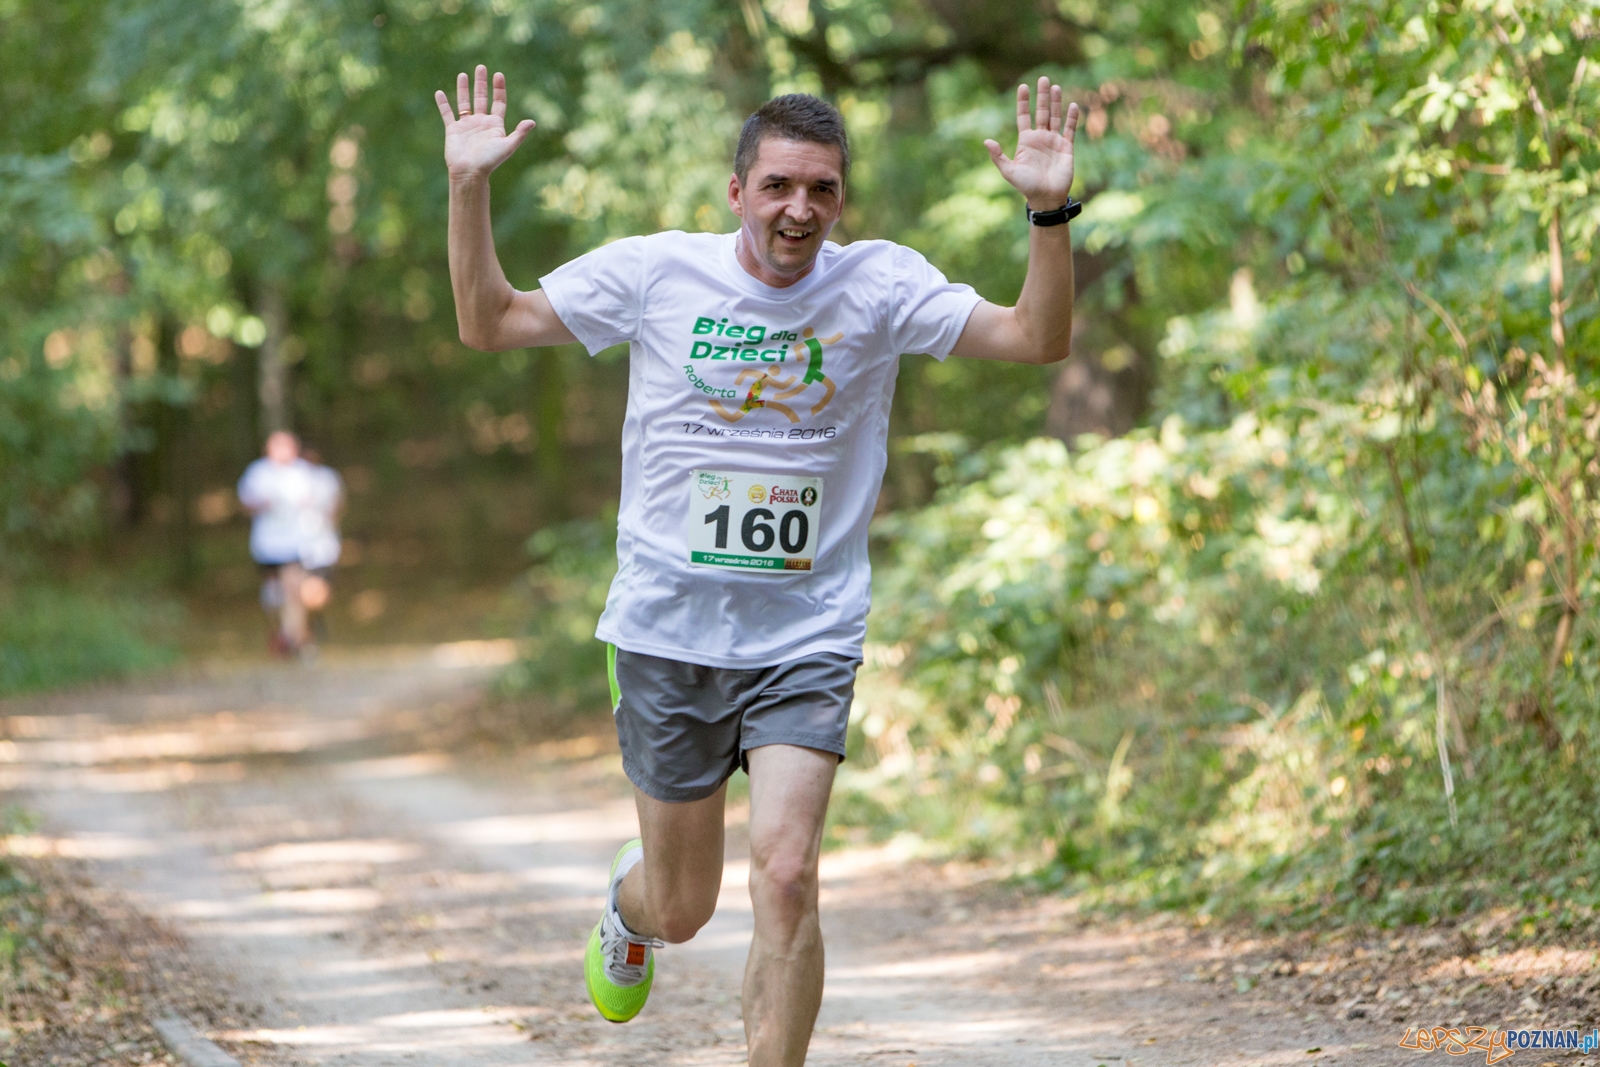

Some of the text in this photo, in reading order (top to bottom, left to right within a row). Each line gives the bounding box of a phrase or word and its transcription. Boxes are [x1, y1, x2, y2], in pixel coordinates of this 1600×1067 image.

[691, 316, 799, 345] Bieg dla
[689, 340, 789, 363] Dzieci
[683, 364, 737, 399] Roberta
[682, 422, 836, 440] 17 września 2016
[704, 504, 809, 554] 160
[749, 558, 775, 567] 2016
